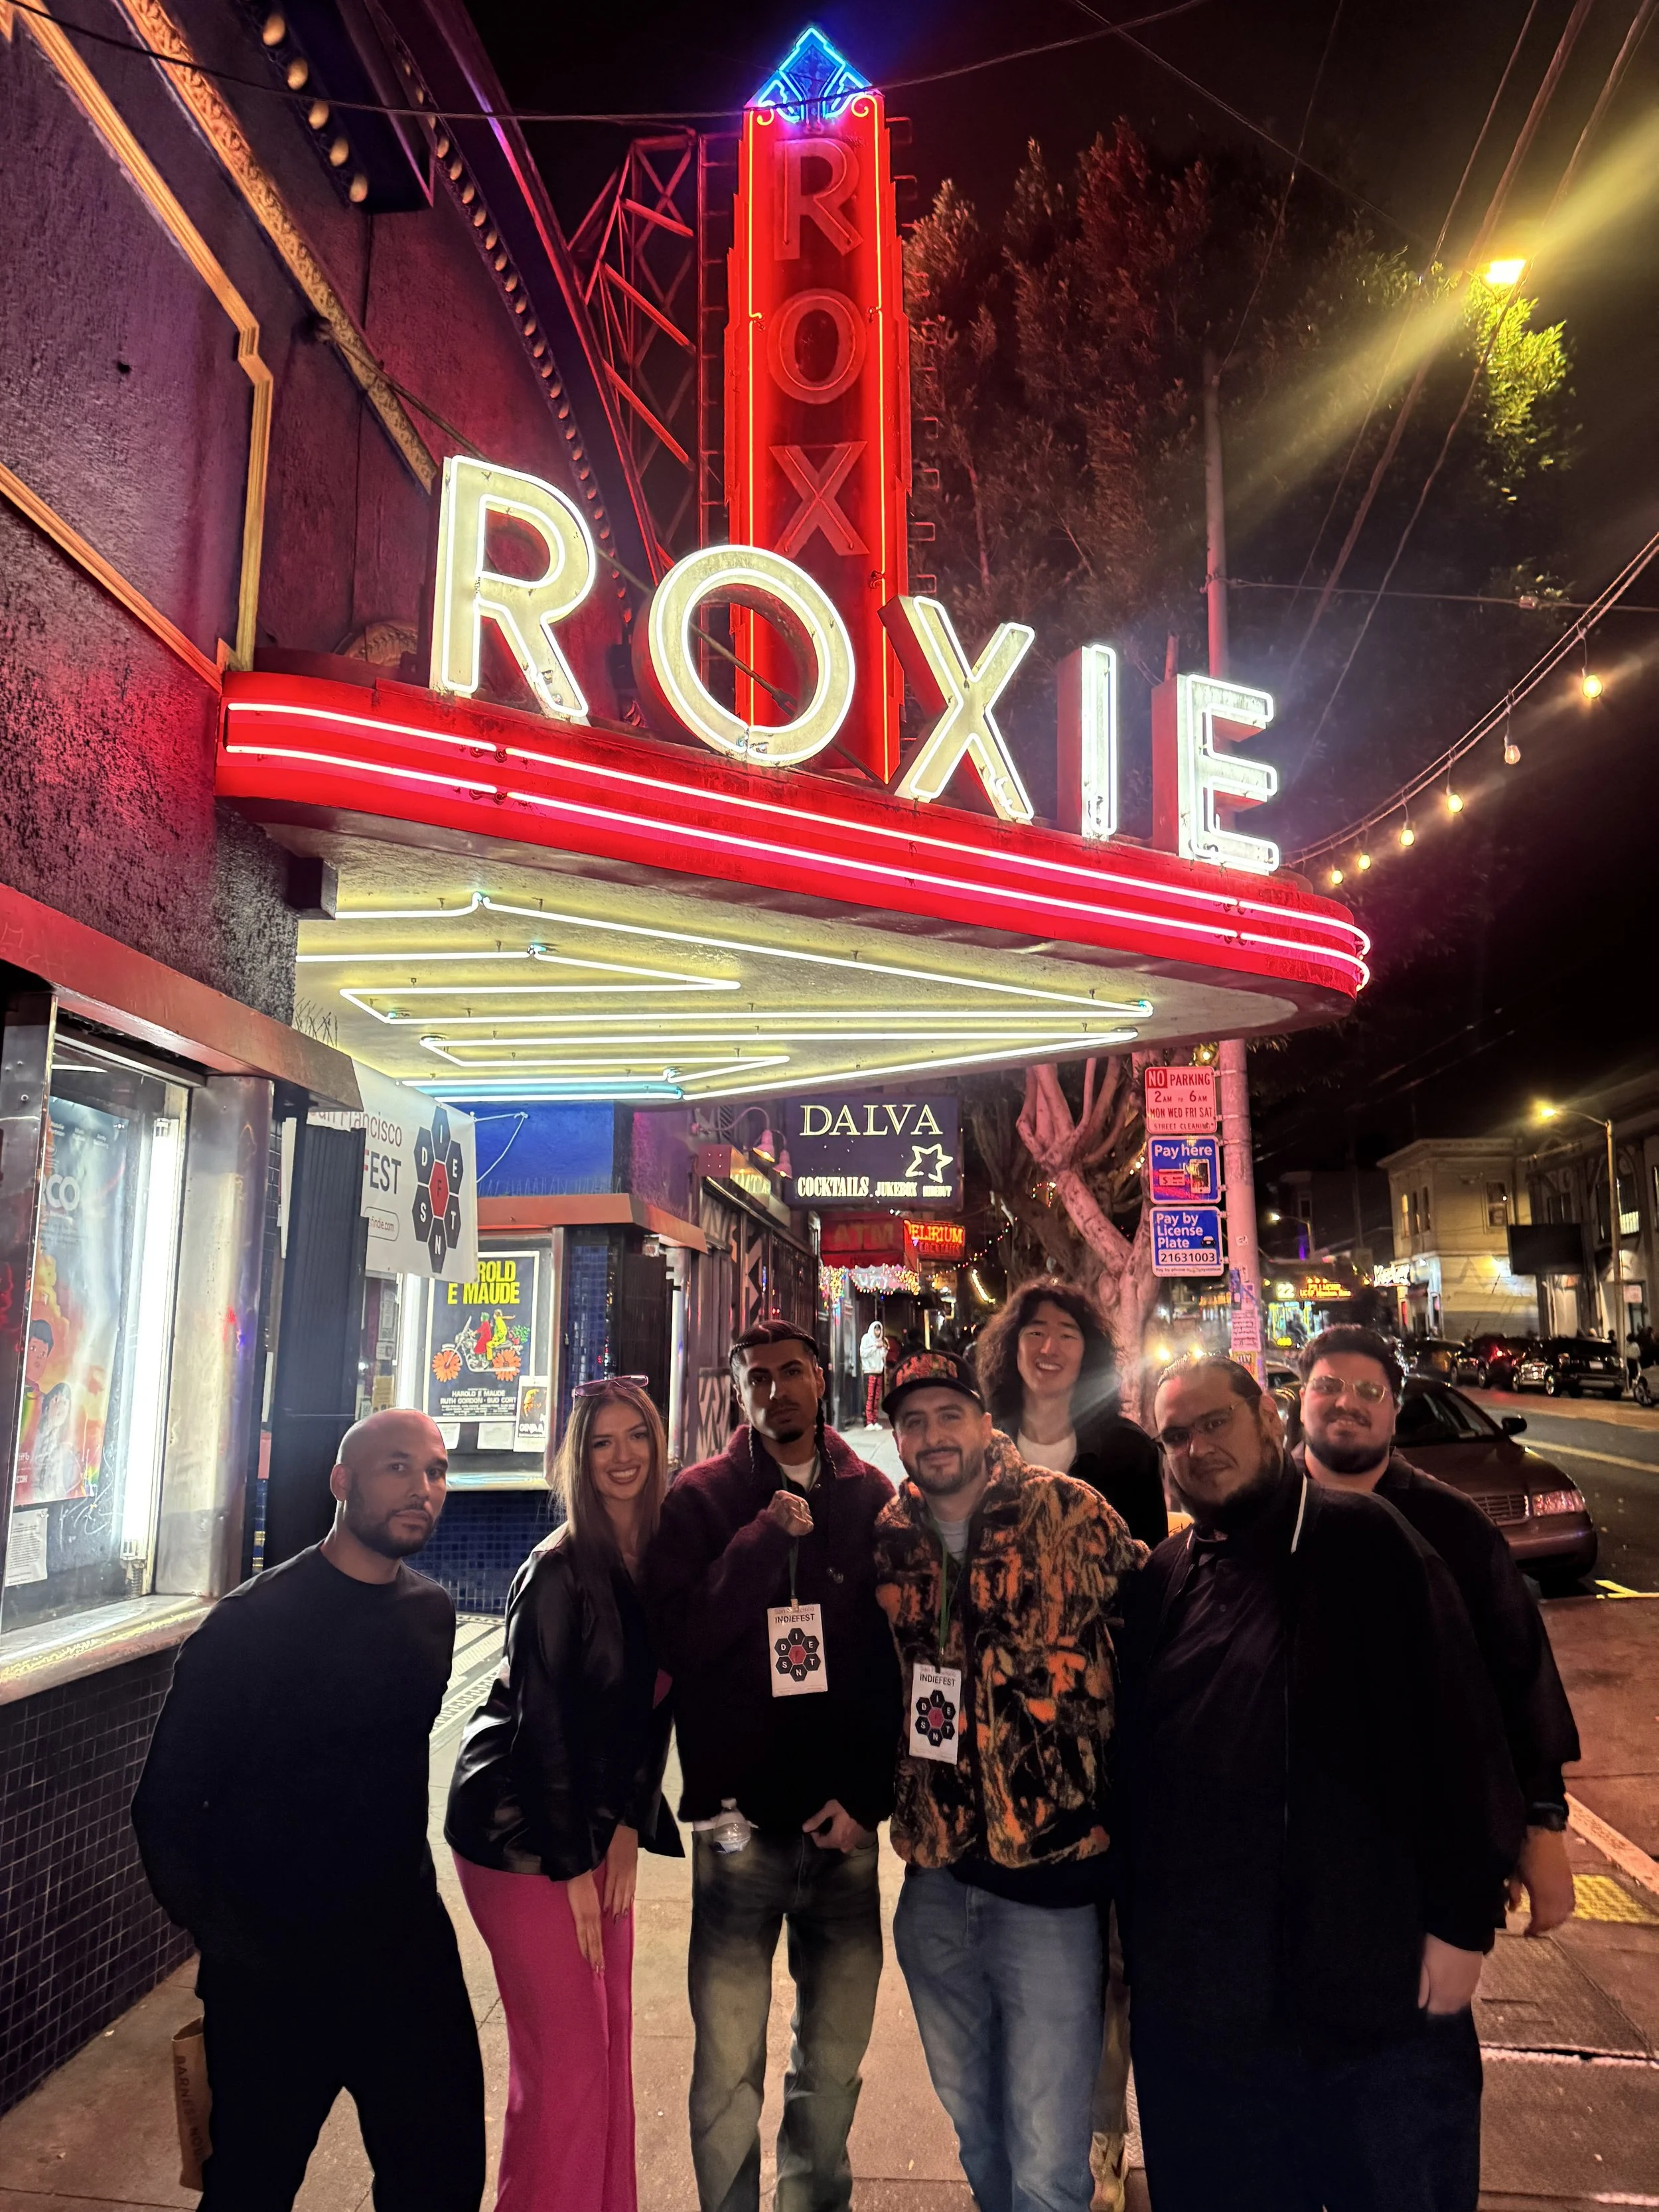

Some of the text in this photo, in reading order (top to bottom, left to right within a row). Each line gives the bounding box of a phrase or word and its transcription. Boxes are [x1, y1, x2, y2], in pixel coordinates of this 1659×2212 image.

[431, 455, 1279, 873] ROXIE
[1148, 1070, 1210, 1087] NO PARKING
[800, 1104, 943, 1136] DALVA
[1150, 1107, 1212, 1118] MON WED FRI SAT
[421, 1146, 428, 1167] D
[1155, 1143, 1212, 1159] Pay here
[452, 1158, 458, 1178] E
[437, 1180, 442, 1197] F
[797, 1176, 869, 1197] COCKTAILS
[875, 1181, 918, 1197] JUKEBOX
[420, 1202, 427, 1222] S
[450, 1211, 457, 1230] T
[1156, 1212, 1198, 1226] Pay by
[1157, 1224, 1203, 1236] License
[435, 1234, 441, 1255] N
[1157, 1236, 1190, 1248] Plate
[1161, 1253, 1215, 1262] 21631003
[477, 1260, 516, 1282] ROLD
[447, 1282, 520, 1305] E MAUDE
[1277, 1283, 1295, 1298] 22
[775, 1613, 816, 1624] INDIEFEST
[919, 1674, 956, 1686] INDIEFEST
[932, 1733, 938, 1741] N
